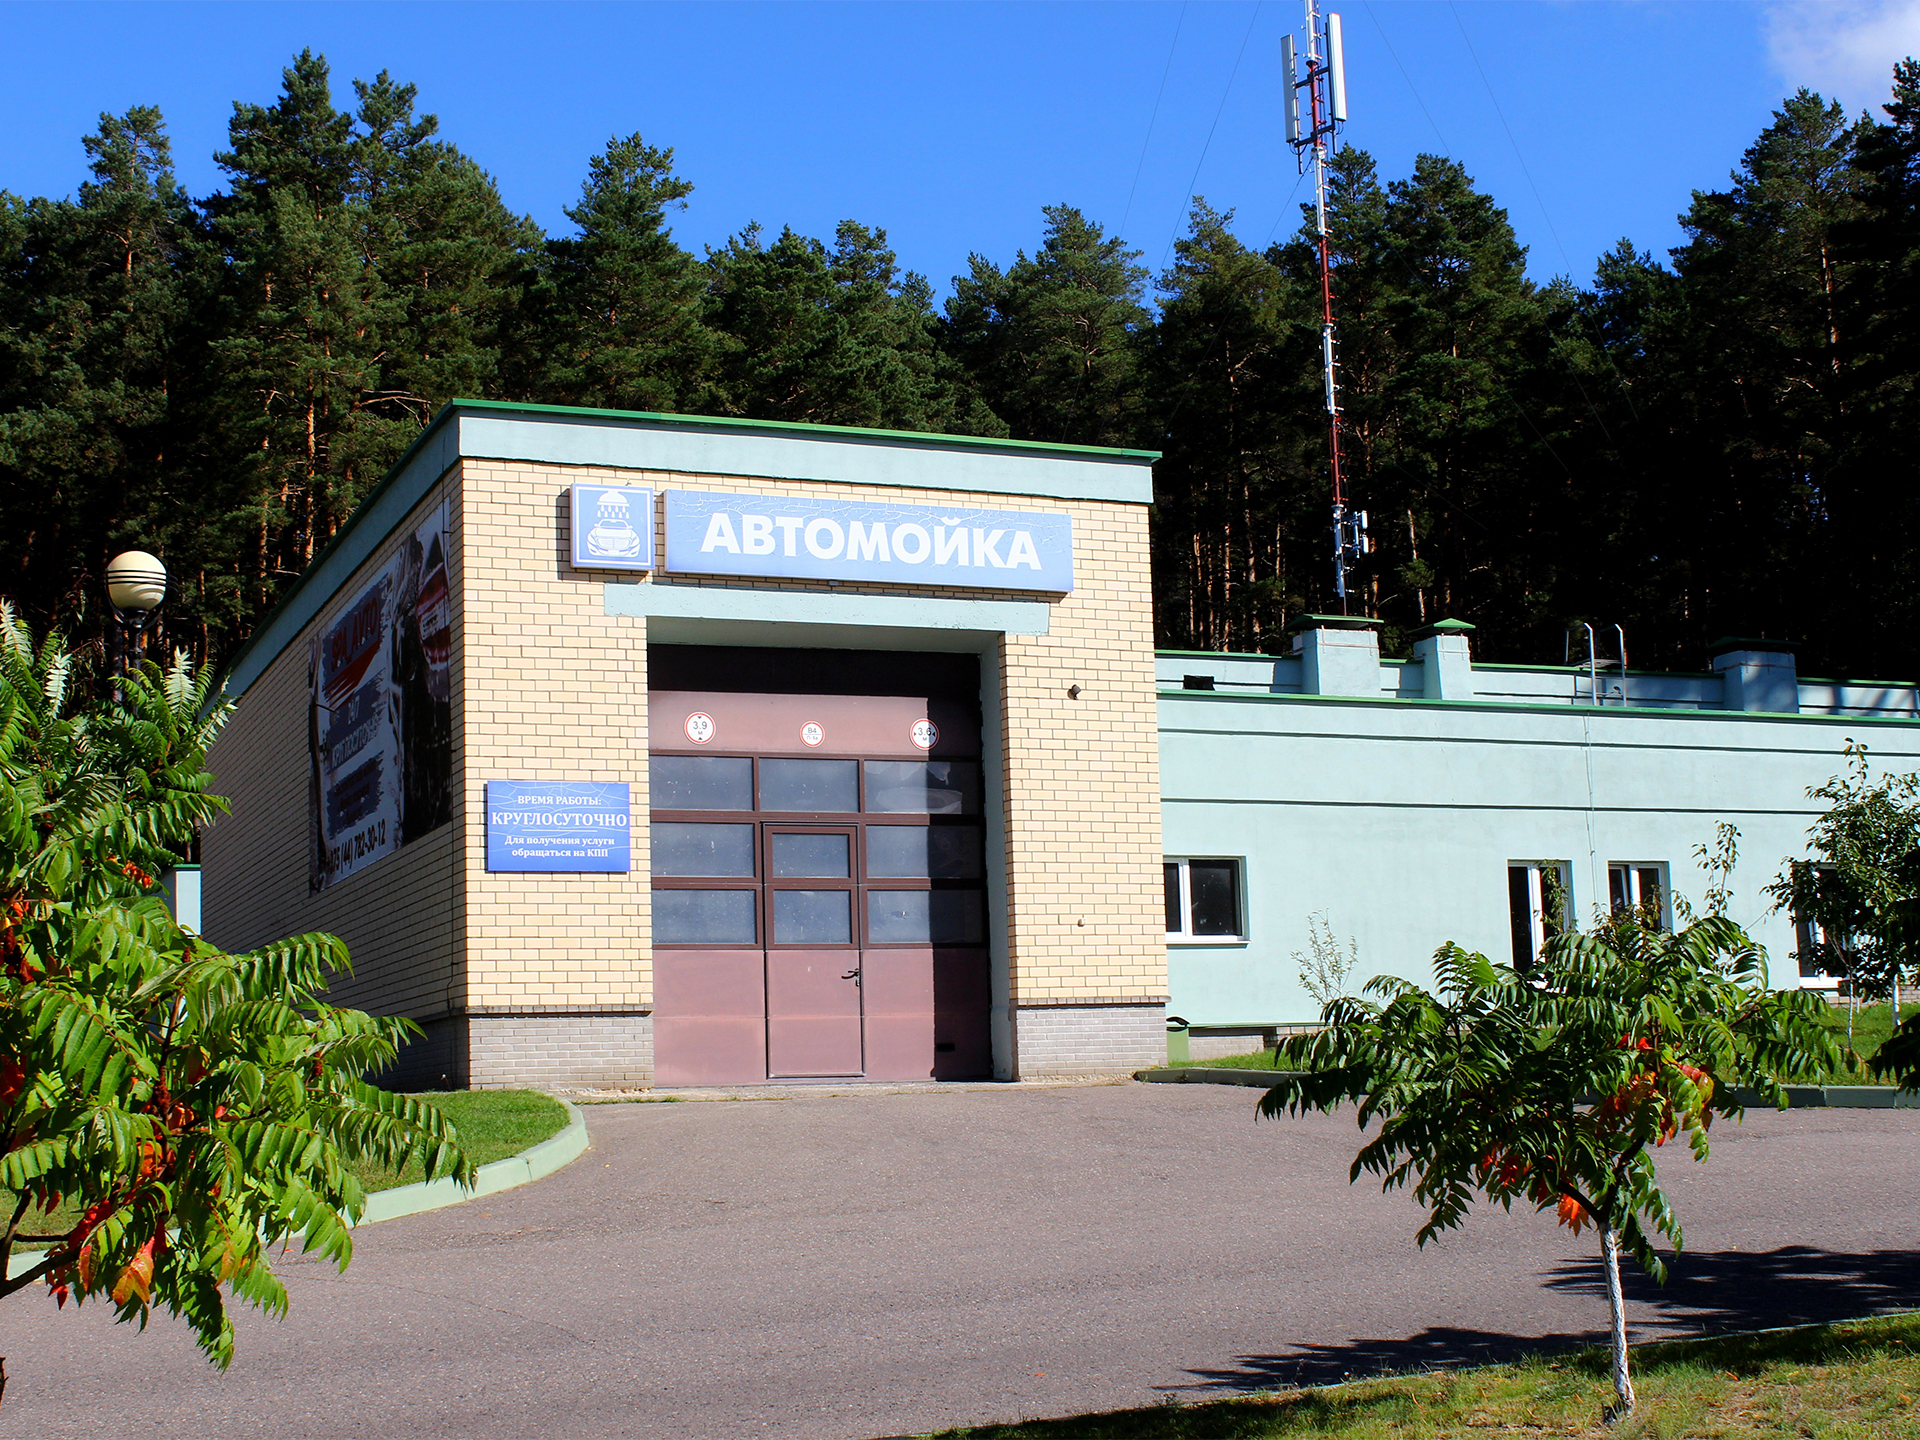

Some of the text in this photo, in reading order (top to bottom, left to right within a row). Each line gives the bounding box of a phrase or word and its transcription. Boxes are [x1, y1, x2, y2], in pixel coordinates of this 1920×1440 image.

[701, 512, 1042, 570] АВТОМОЙКА
[693, 720, 708, 730] 3.9
[517, 795, 602, 806] ВРЕМЯ РАБОТЫ:
[491, 811, 627, 827] КРУГЛОСУТОЧНО
[504, 836, 615, 847] Для получения услуги
[512, 848, 571, 858] обращаться
[587, 849, 608, 857] КПП
